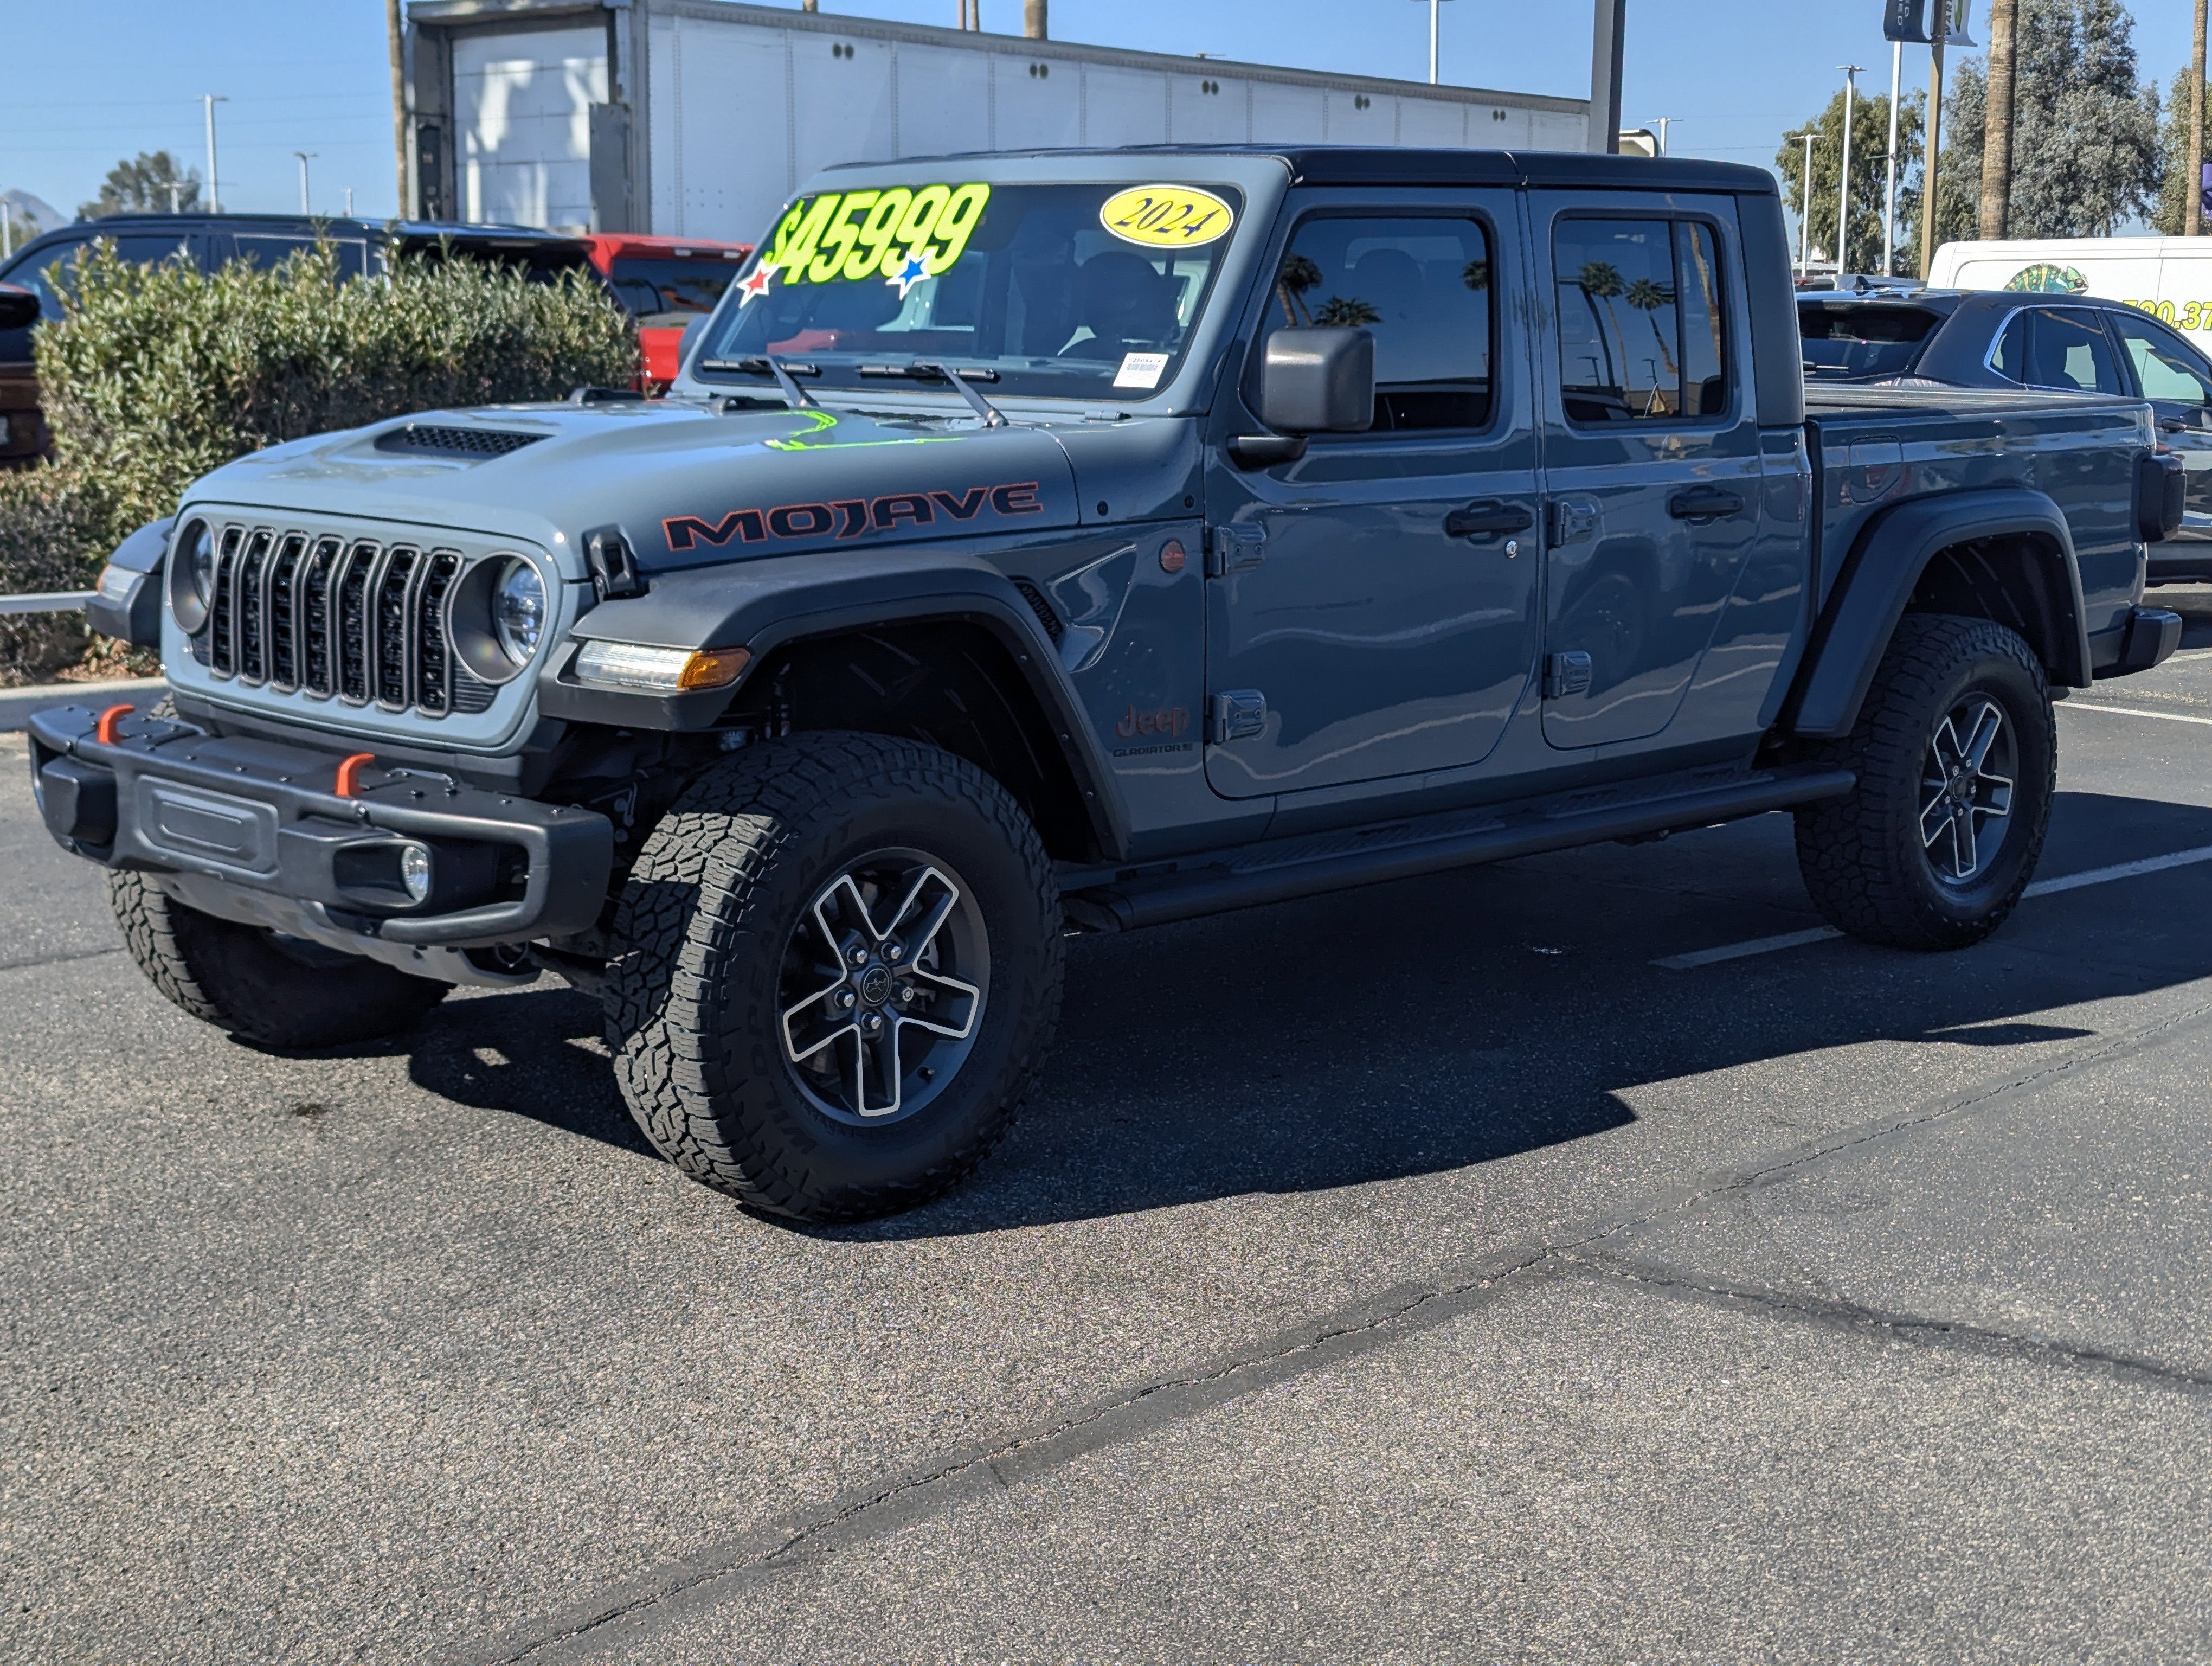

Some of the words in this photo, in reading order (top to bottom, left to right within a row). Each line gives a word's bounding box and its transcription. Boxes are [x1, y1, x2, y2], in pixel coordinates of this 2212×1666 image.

[763, 182, 991, 285] $45999
[1113, 197, 1221, 238] 2024
[661, 482, 1044, 552] MOJAVE
[1116, 704, 1190, 738] Jeep
[1113, 744, 1181, 758] GLADIATOR
